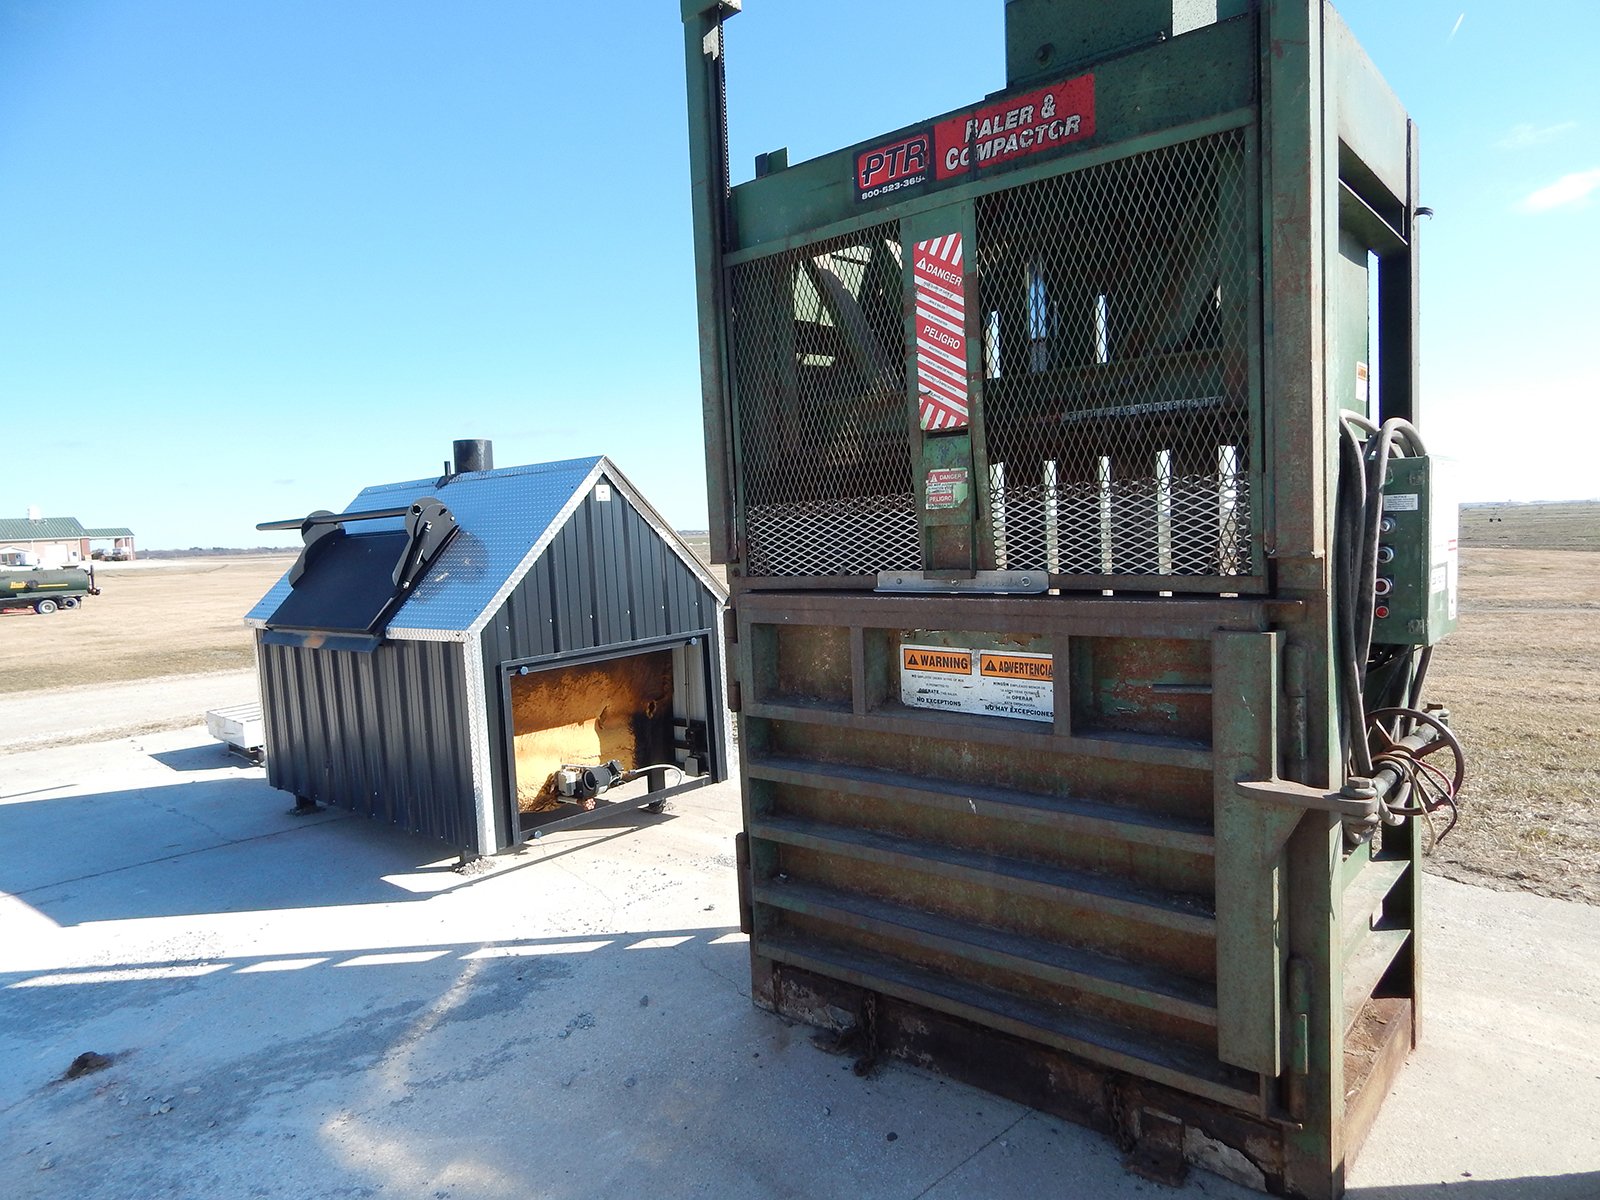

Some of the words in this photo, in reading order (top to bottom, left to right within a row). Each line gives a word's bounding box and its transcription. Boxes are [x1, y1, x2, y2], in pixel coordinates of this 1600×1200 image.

[964, 104, 1035, 144] BALER
[1040, 94, 1056, 119] &
[945, 114, 1081, 171] COMPACTOR
[862, 137, 929, 187] PTR
[926, 263, 962, 287] DANGER
[923, 325, 960, 350] PELIGRO
[920, 655, 968, 669] WARNING
[998, 660, 1053, 677] ADVERTENCIA
[926, 698, 961, 707] EXCEPTIONS
[984, 703, 994, 711] NO
[1010, 706, 1055, 718] EXCEPCIONES
